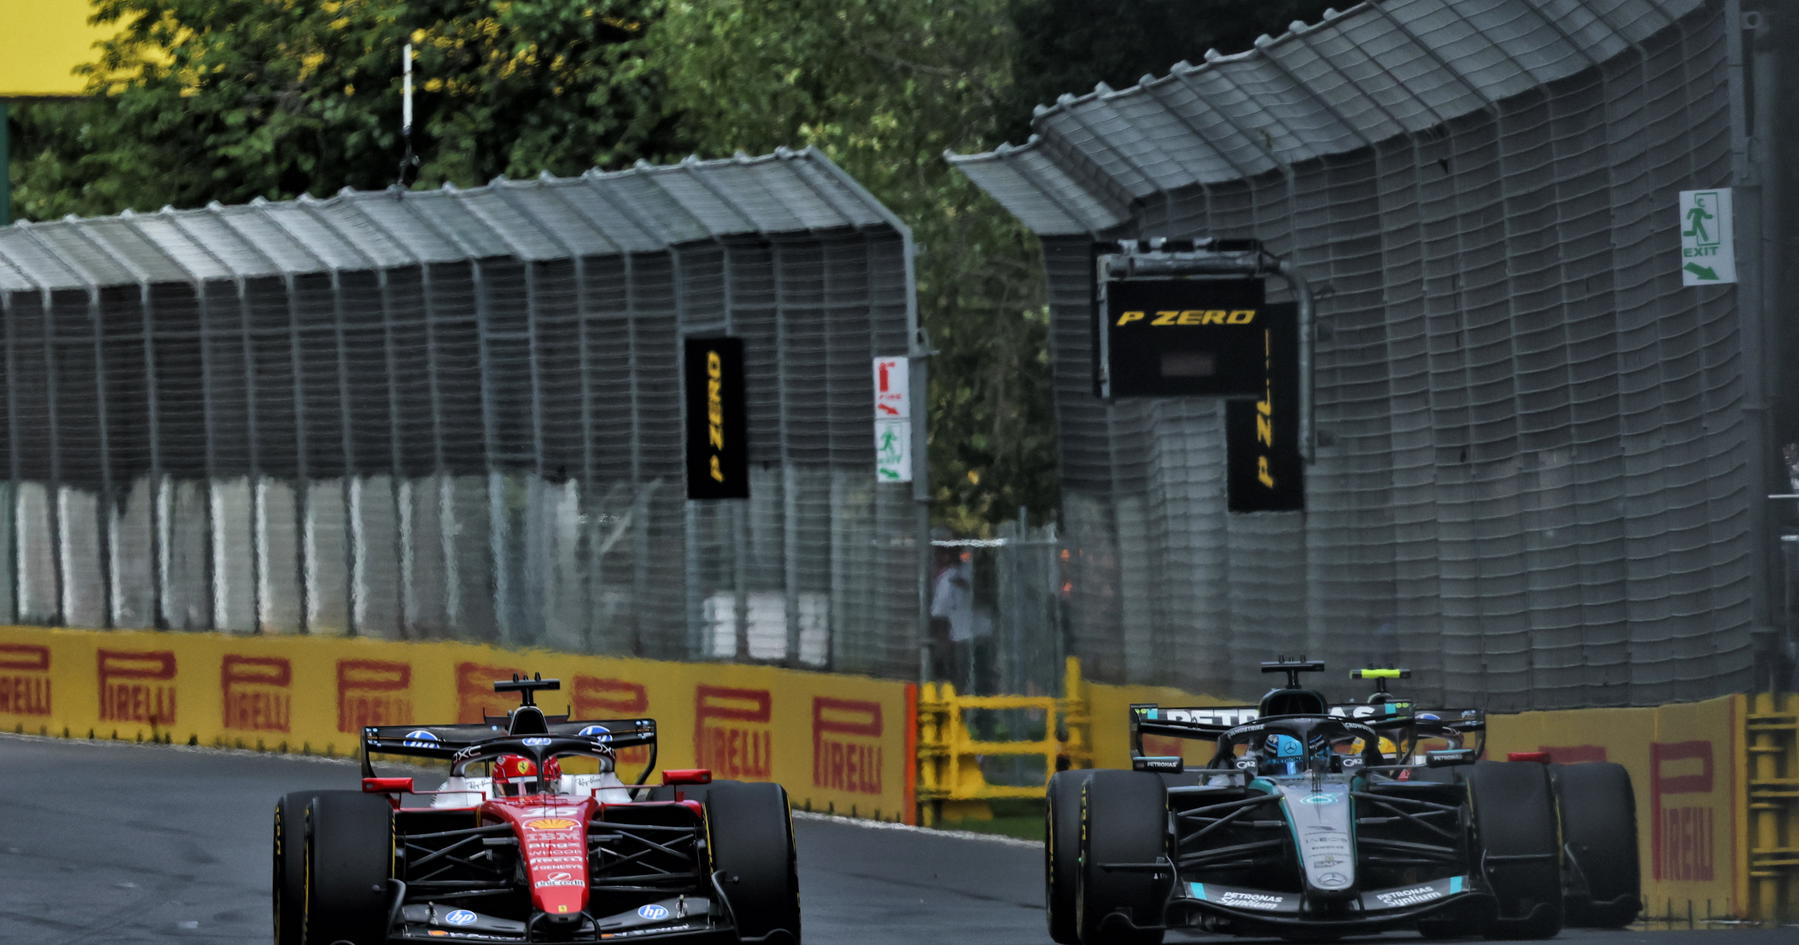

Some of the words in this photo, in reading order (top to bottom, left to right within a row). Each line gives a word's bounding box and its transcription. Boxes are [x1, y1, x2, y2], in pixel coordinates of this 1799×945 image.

[1683, 246, 1719, 257] EXIT
[1116, 311, 1145, 326] P
[1151, 310, 1256, 326] ZERO
[707, 351, 724, 450] ZERO
[709, 454, 725, 482] P
[1257, 455, 1274, 488] P
[97, 648, 176, 724] PIRELLI
[221, 653, 291, 733] PIRELLI
[694, 683, 773, 778] PIRELLI
[812, 695, 884, 795] PIRELLI
[1651, 740, 1714, 882] PIRELLI
[1223, 891, 1284, 903] PETRONAS
[1376, 885, 1434, 900] PETRONAS
[1383, 891, 1442, 907] Syntium
[448, 911, 476, 924] hp
[640, 904, 667, 919] hp
